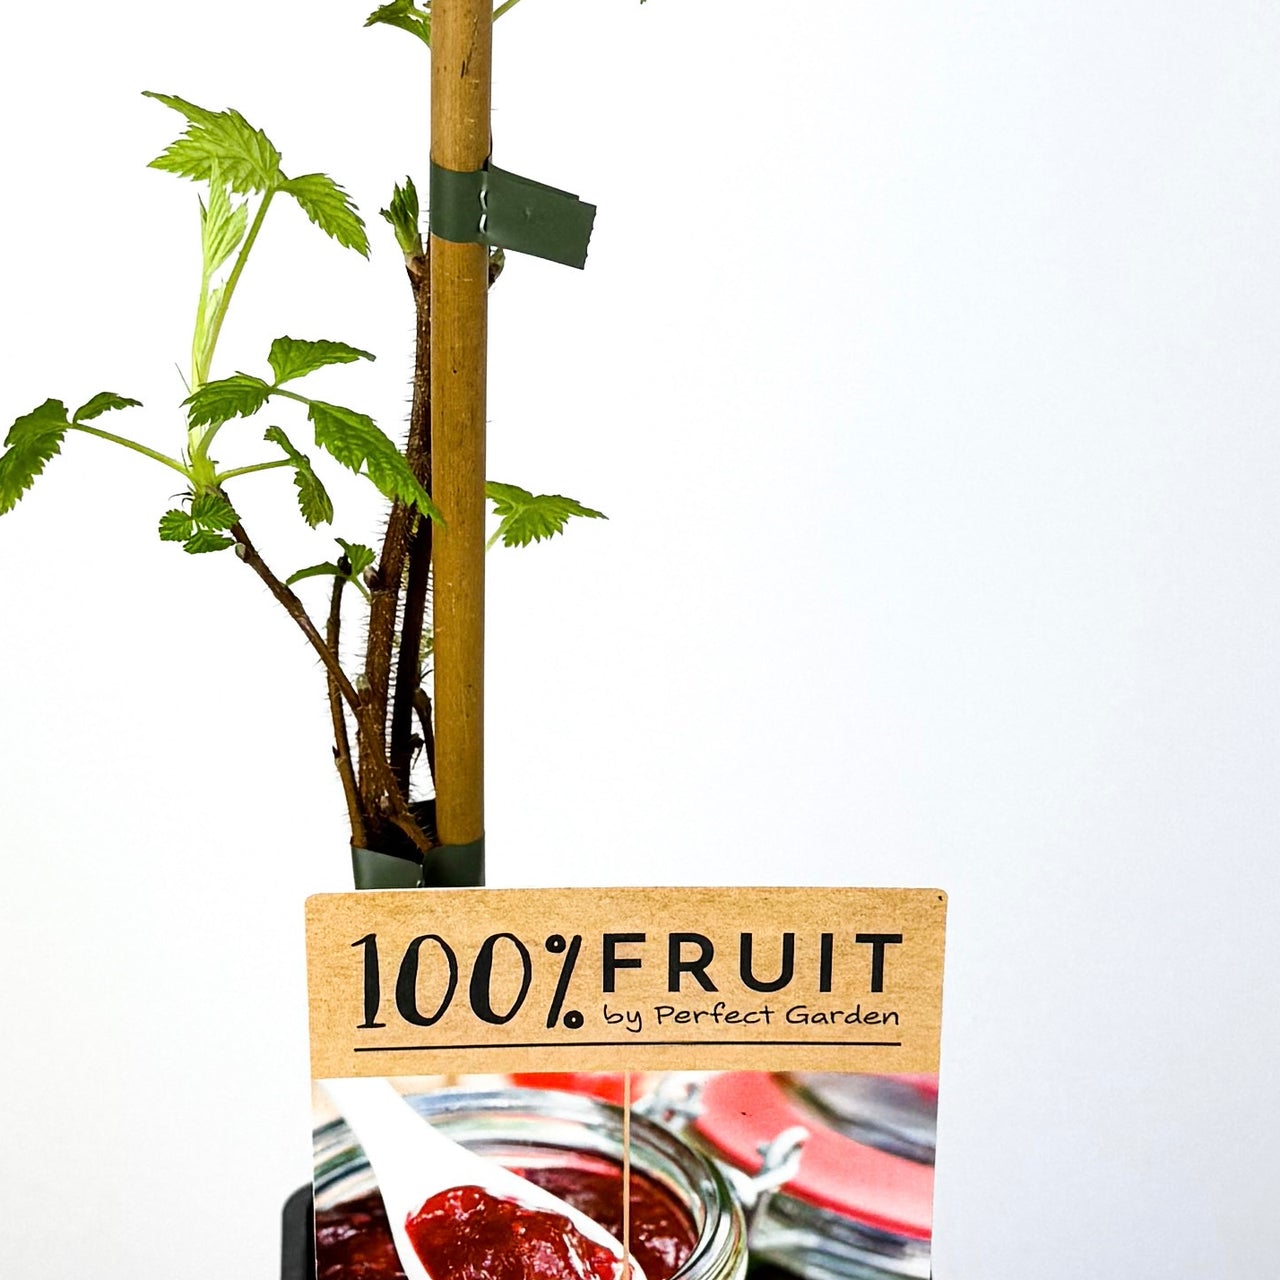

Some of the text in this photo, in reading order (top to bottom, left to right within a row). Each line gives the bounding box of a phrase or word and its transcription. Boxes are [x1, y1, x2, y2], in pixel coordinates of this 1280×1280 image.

[352, 932, 903, 1029] 100% FRUIT
[603, 1001, 899, 1033] by Perfect Garden
